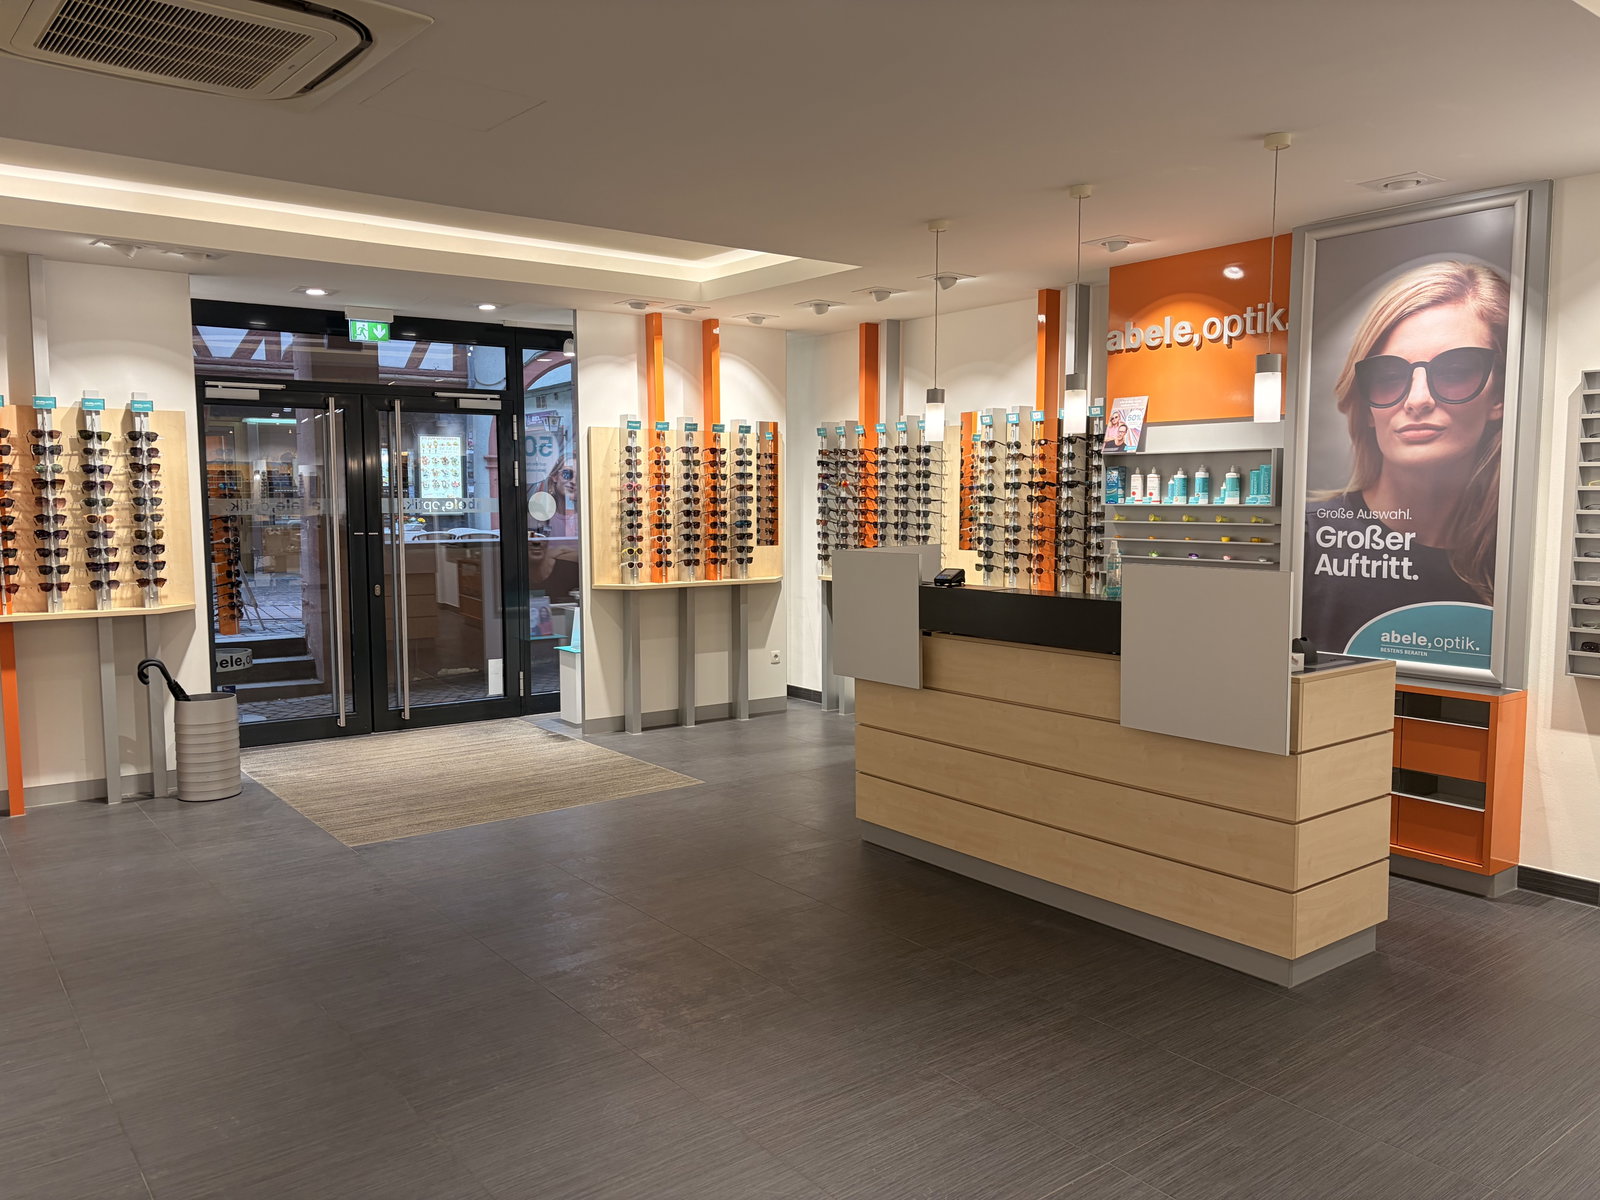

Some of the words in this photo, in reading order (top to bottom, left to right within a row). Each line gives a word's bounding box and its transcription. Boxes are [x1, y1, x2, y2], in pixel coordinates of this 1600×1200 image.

[1316, 507, 1354, 519] Große
[1356, 508, 1413, 520] Auswahl.
[1315, 524, 1416, 551] Großer
[1314, 552, 1419, 581] Auftritt.
[1380, 630, 1480, 651] abele,optik.
[1380, 647, 1404, 655] BESTENS
